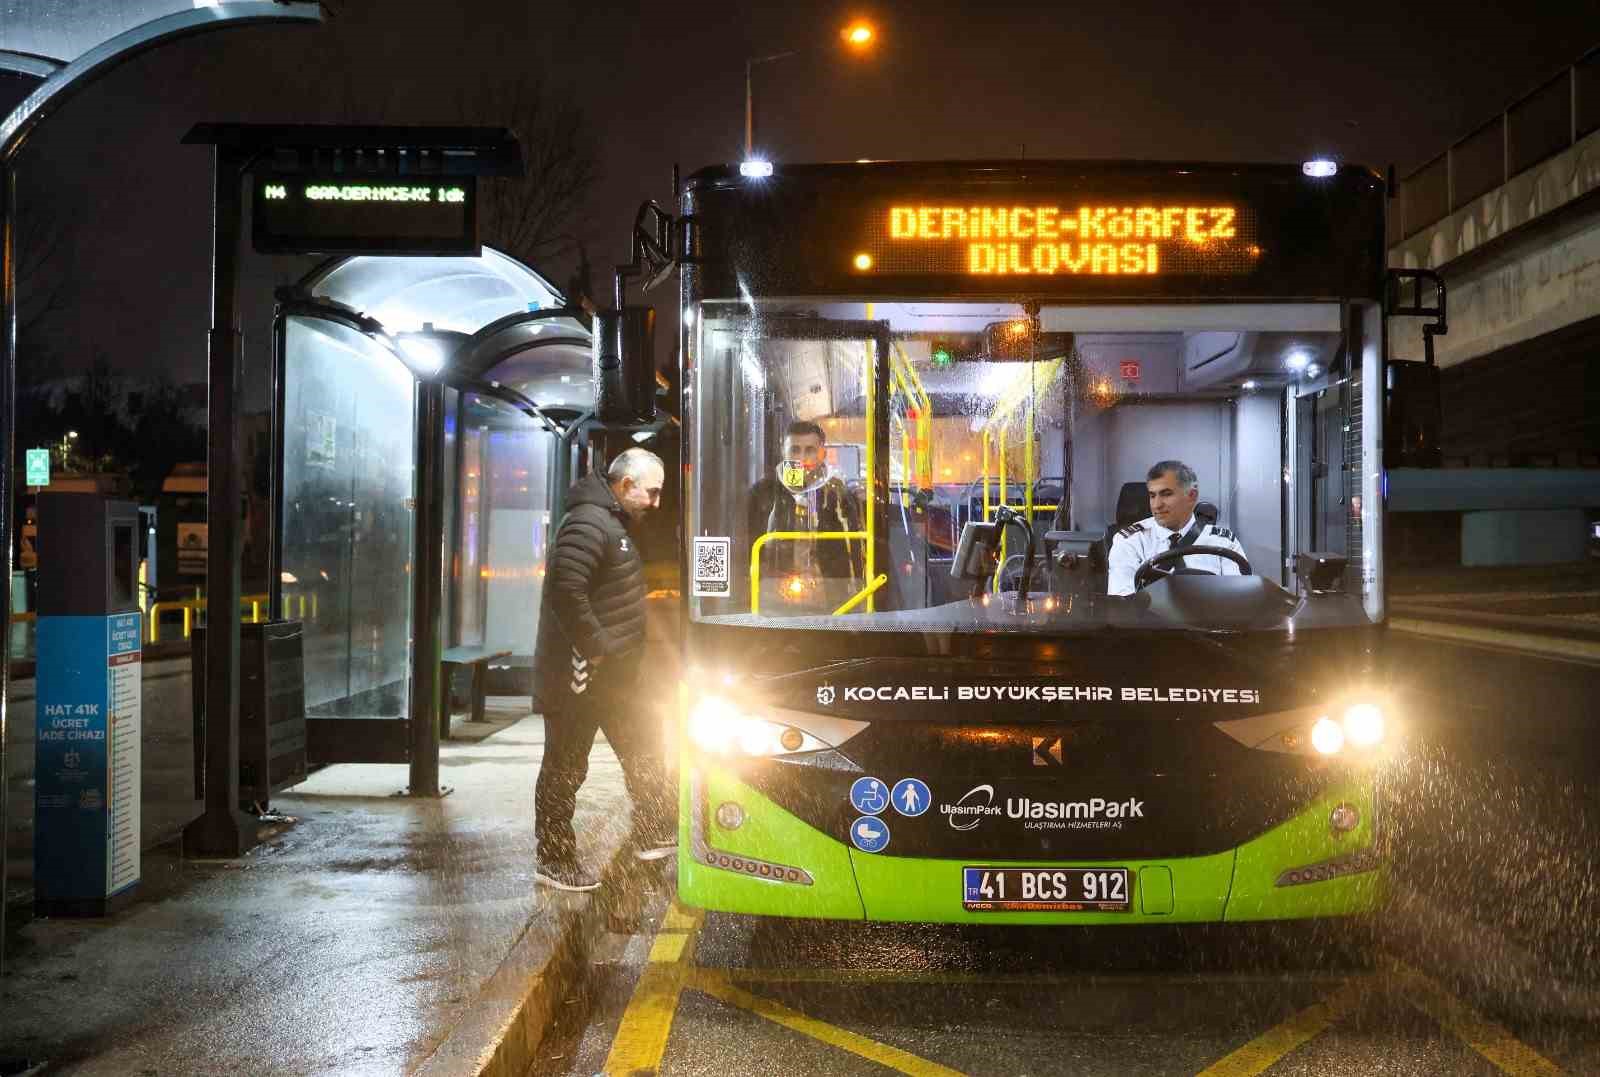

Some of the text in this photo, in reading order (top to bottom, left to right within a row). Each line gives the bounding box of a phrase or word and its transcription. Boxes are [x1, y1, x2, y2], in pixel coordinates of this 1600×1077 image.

[969, 243, 1158, 273] DİLOVASI
[844, 685, 1260, 704] KOCAELİ BÜYÜKŞEHİR BELEDİYESİ
[45, 704, 99, 715] HAT 41K
[52, 717, 89, 728] ÜCRET
[39, 728, 104, 740] İADE CİHAZI
[967, 871, 1125, 900] TR 41 BCS 912
